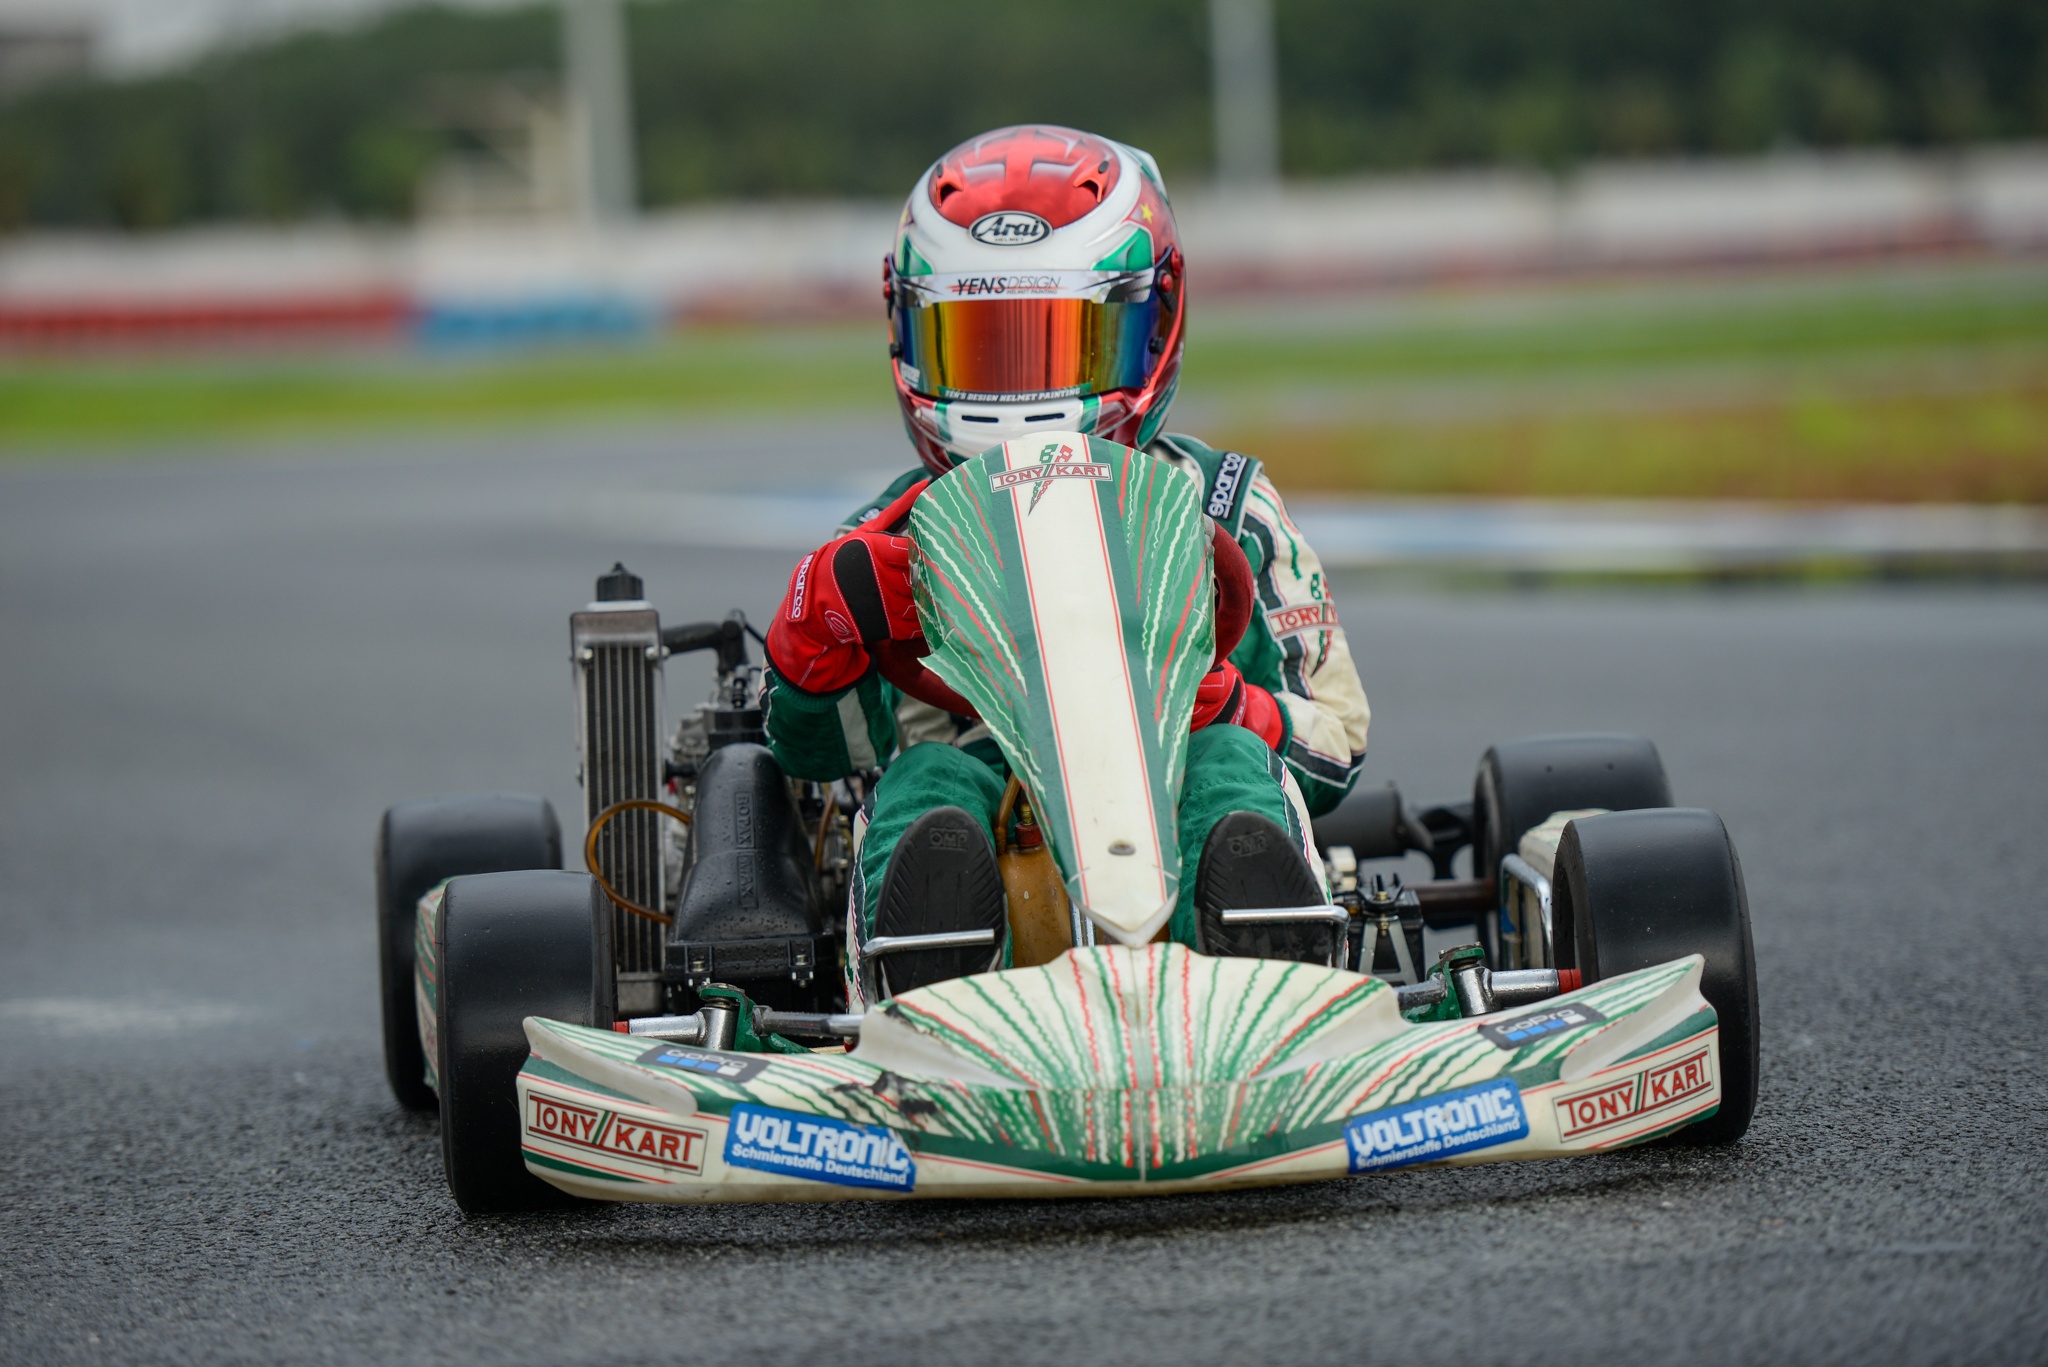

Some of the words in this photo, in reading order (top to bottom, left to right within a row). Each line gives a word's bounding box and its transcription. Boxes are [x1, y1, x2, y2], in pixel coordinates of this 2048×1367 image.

[976, 216, 1041, 237] Arai
[1007, 275, 1061, 289] DESIGN
[966, 392, 999, 402] DESIGN
[999, 393, 1037, 402] HELMET
[1037, 386, 1081, 401] PAINTING
[993, 466, 1043, 486] TONY
[1056, 464, 1107, 477] KART
[1208, 452, 1246, 519] sparco
[792, 554, 814, 619] sparco
[1270, 606, 1320, 634] TONY
[739, 796, 752, 846] ROTAX
[1495, 1009, 1575, 1034] GoPro
[666, 1049, 748, 1069] GoPro
[1557, 1080, 1634, 1128] TONY
[1651, 1051, 1708, 1102] KART
[529, 1094, 598, 1141] TONY
[615, 1117, 703, 1162] KART
[736, 1112, 909, 1171] VOLTRONIC
[1351, 1087, 1517, 1156] VOLTRONIC
[1356, 1138, 1443, 1170] Schmierstoffe
[1443, 1118, 1521, 1150] Deutschland
[731, 1143, 823, 1173] Schmierstoffe
[825, 1160, 907, 1185] Deutschland
